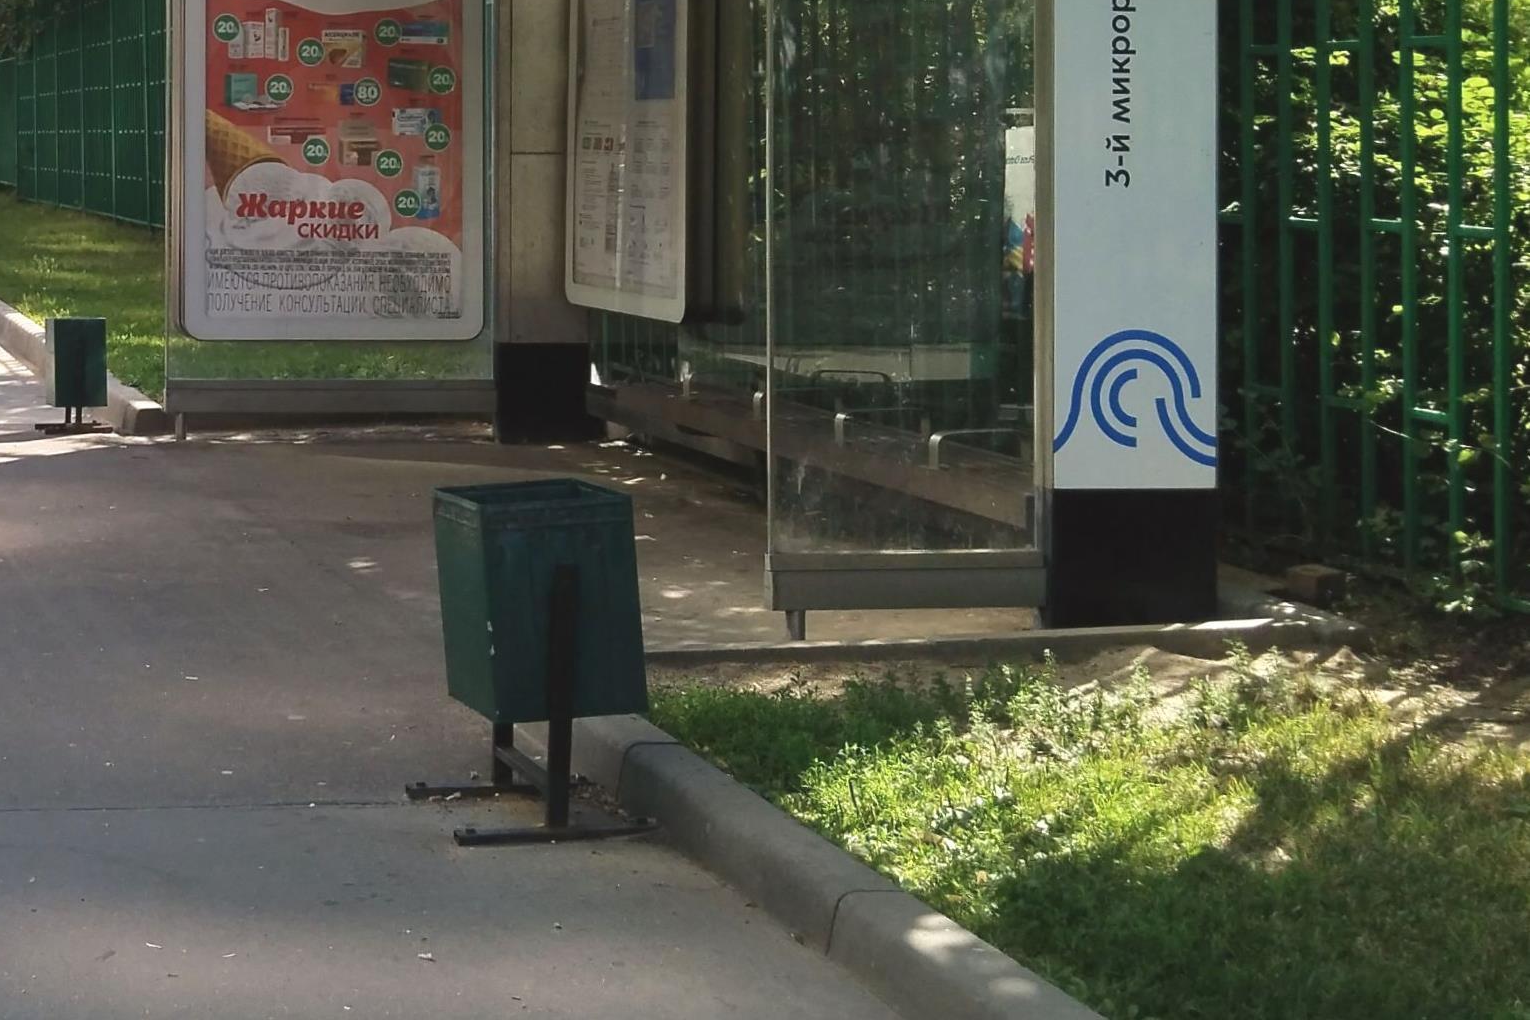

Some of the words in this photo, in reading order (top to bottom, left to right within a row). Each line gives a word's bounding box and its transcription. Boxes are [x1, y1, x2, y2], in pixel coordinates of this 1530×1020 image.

[357, 86, 378, 99] 80
[1105, 135, 1131, 188] 3-й
[236, 193, 365, 225] Жаркие
[207, 292, 272, 312] ПОЛУЧЕНИЕ
